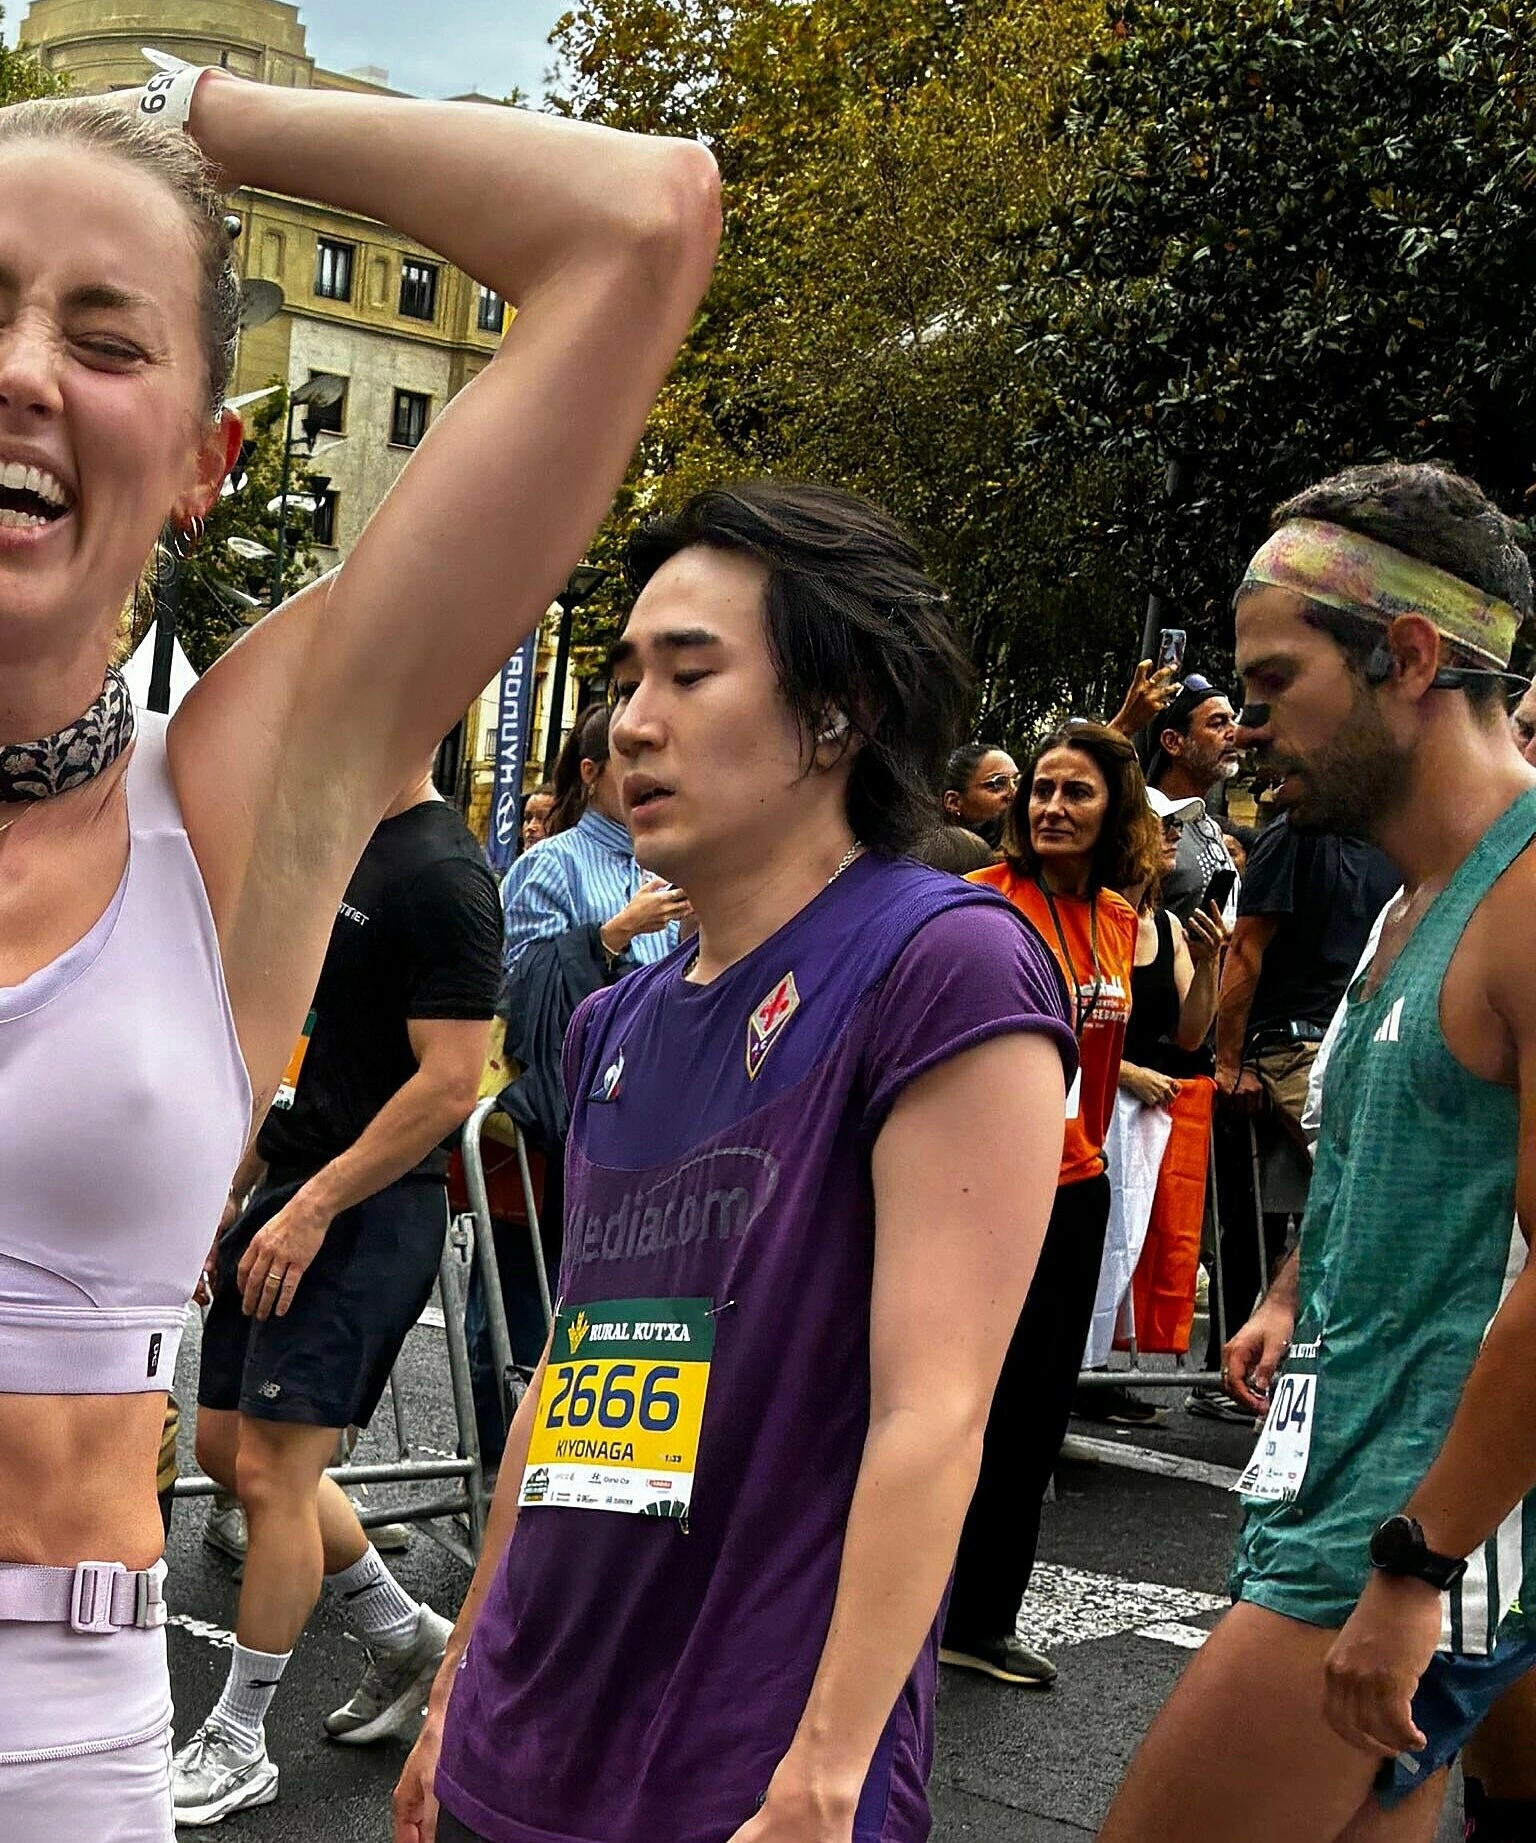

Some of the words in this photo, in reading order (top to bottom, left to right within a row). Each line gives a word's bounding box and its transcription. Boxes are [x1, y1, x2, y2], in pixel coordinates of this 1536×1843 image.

[499, 647, 524, 784] HYUNDA
[588, 1322, 631, 1342] RURAL
[631, 1321, 692, 1342] KUTXA
[546, 1364, 680, 1432] 2666
[555, 1439, 634, 1462] KIYONAGA
